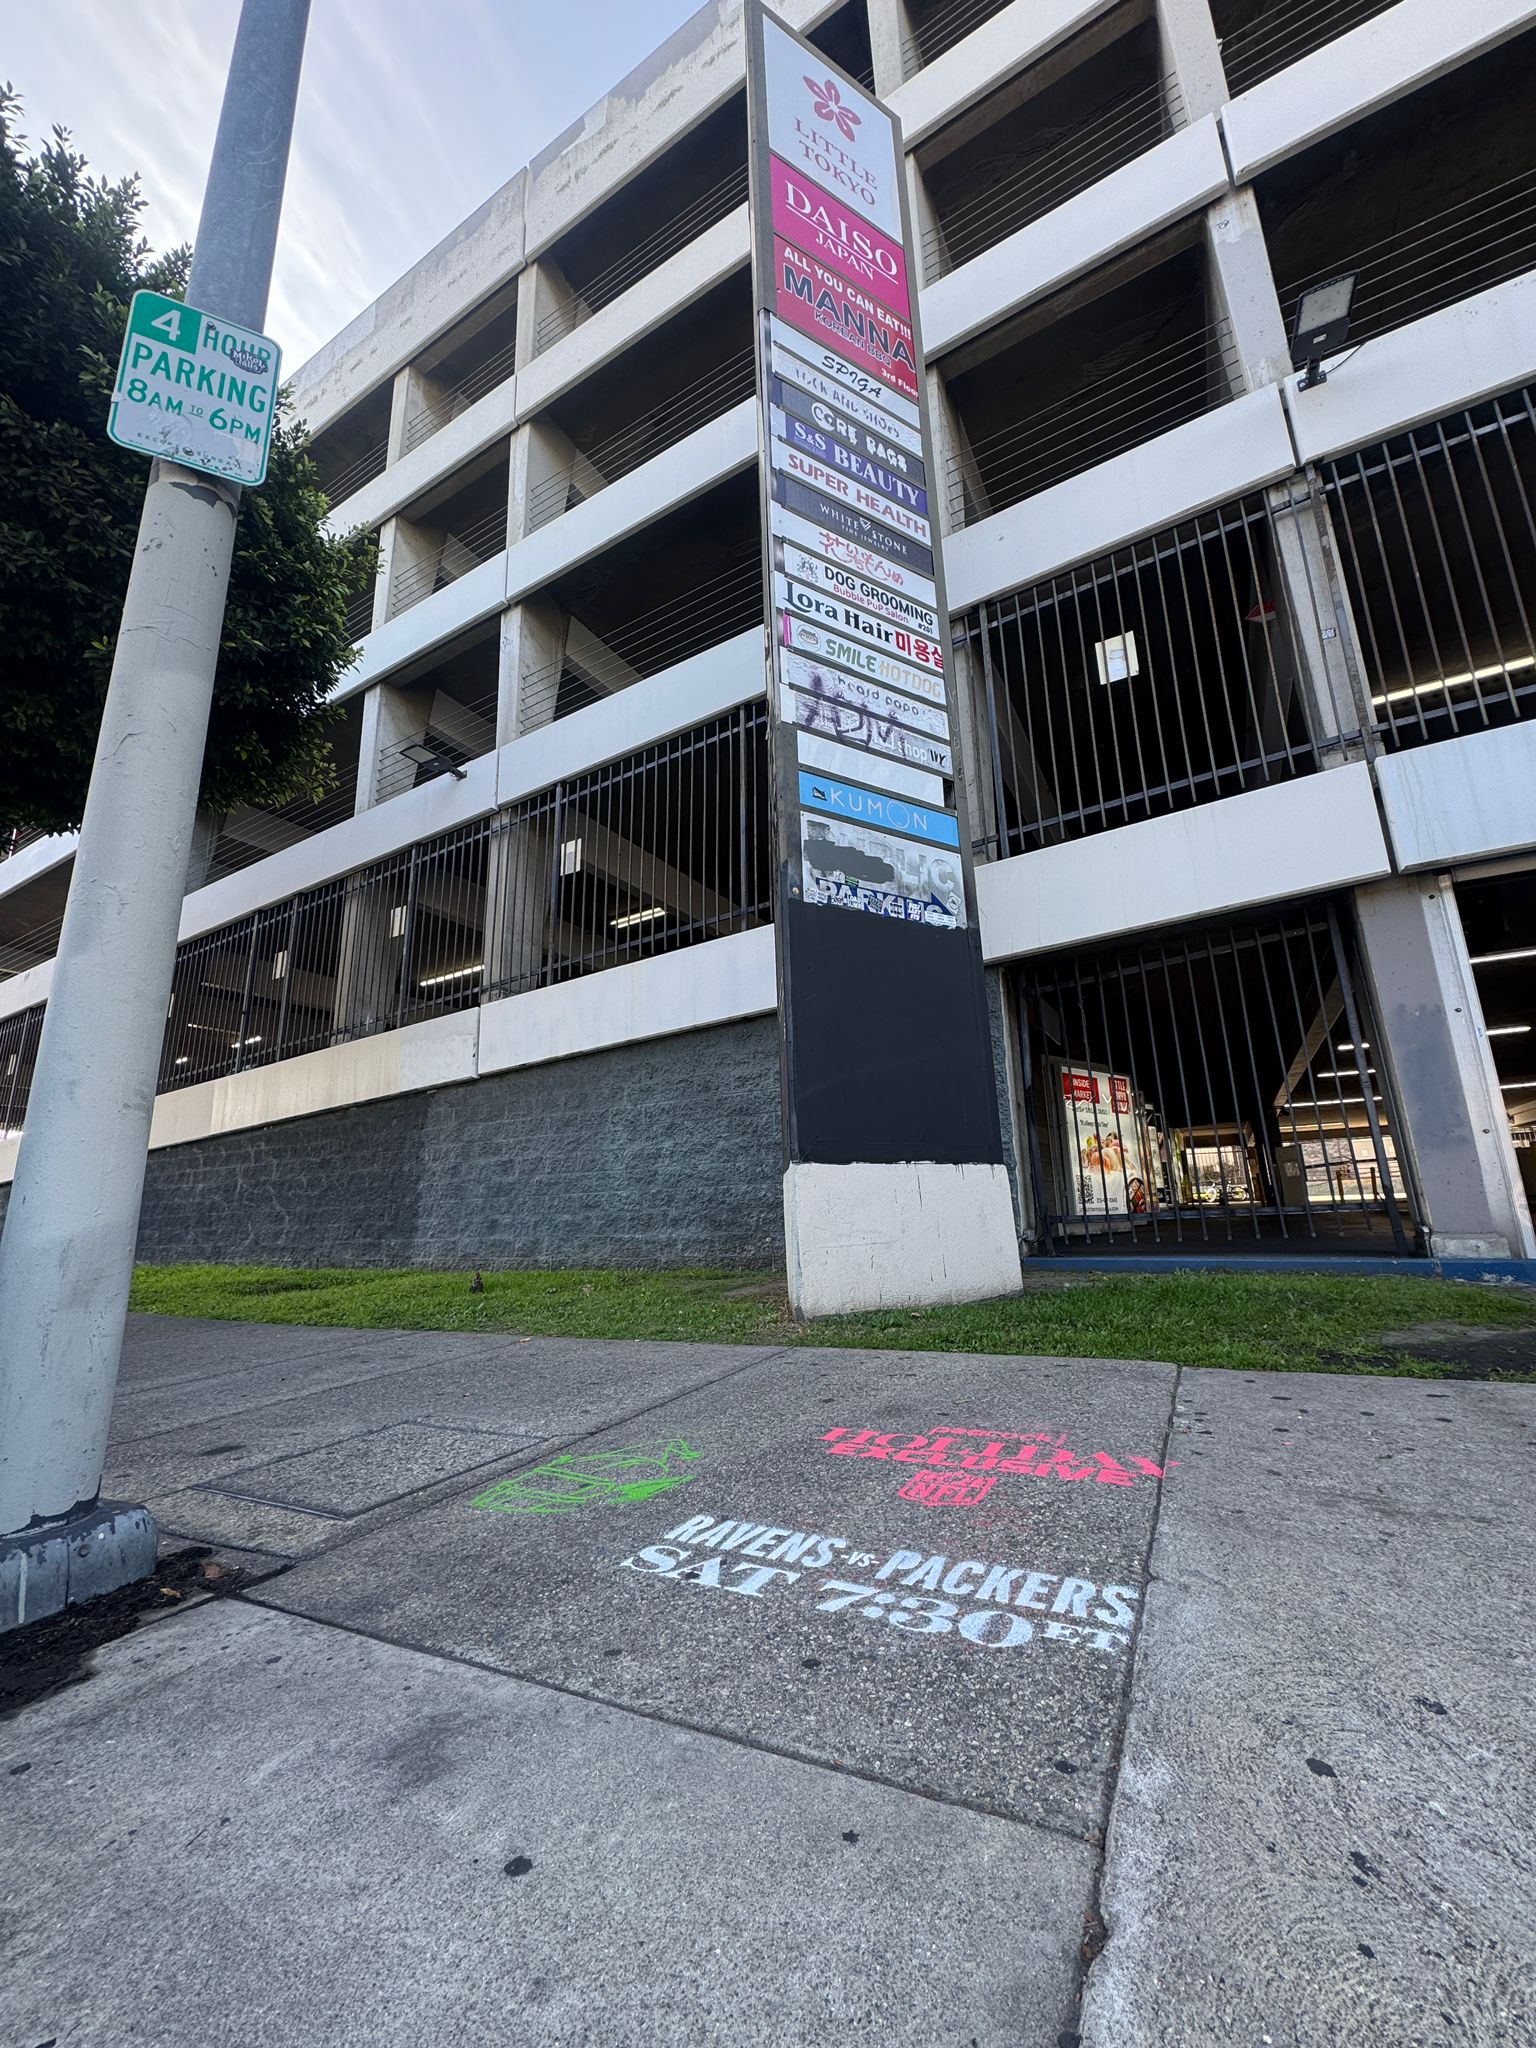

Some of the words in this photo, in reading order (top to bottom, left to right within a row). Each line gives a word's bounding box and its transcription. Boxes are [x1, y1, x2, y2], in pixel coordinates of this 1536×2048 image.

[794, 117, 878, 190] LITTLE
[798, 139, 876, 207] TOKYO
[785, 180, 898, 276] DAISO
[815, 229, 874, 281] JAPAN
[783, 246, 811, 273] ALL
[813, 263, 844, 293] YOU
[847, 285, 874, 314] CAN
[876, 306, 912, 341] EAT!!!
[783, 263, 916, 373] MANNA
[151, 309, 182, 342] 4
[813, 309, 865, 351] KOREAN
[866, 342, 892, 369] BBQ
[131, 342, 267, 414] PARKING
[821, 354, 883, 399] SPIGA
[881, 367, 896, 384] 3rd
[897, 378, 919, 398] Floor
[127, 378, 183, 416] 8AM
[189, 405, 204, 417] TO
[209, 408, 261, 445] 6PM
[794, 421, 827, 451] S&S
[833, 443, 920, 507] BEAUTY
[788, 453, 849, 497] SUPER
[856, 488, 927, 539] HEALTH
[819, 503, 860, 531] WHITE
[872, 530, 908, 555] STONE
[782, 580, 839, 622] Lora
[843, 608, 894, 644] Hair
[824, 565, 856, 591] DOG
[860, 582, 934, 626] GROOMING
[833, 583, 866, 605] Bubble
[885, 606, 909, 624] Salon
[825, 637, 878, 674] SMILE
[880, 659, 943, 698] HOTDOG
[894, 629, 944, 670] 미용실
[830, 787, 929, 832] KUMON
[817, 1427, 1180, 1479] HOLIDAY
[825, 1442, 1138, 1487] EXCLUSIVE
[619, 1544, 803, 1598] SAT
[815, 1578, 1034, 1649] 7:30
[1040, 1620, 1132, 1652] ET
[663, 1514, 847, 1568] RAVENS
[874, 1550, 1139, 1629] PACKERS
